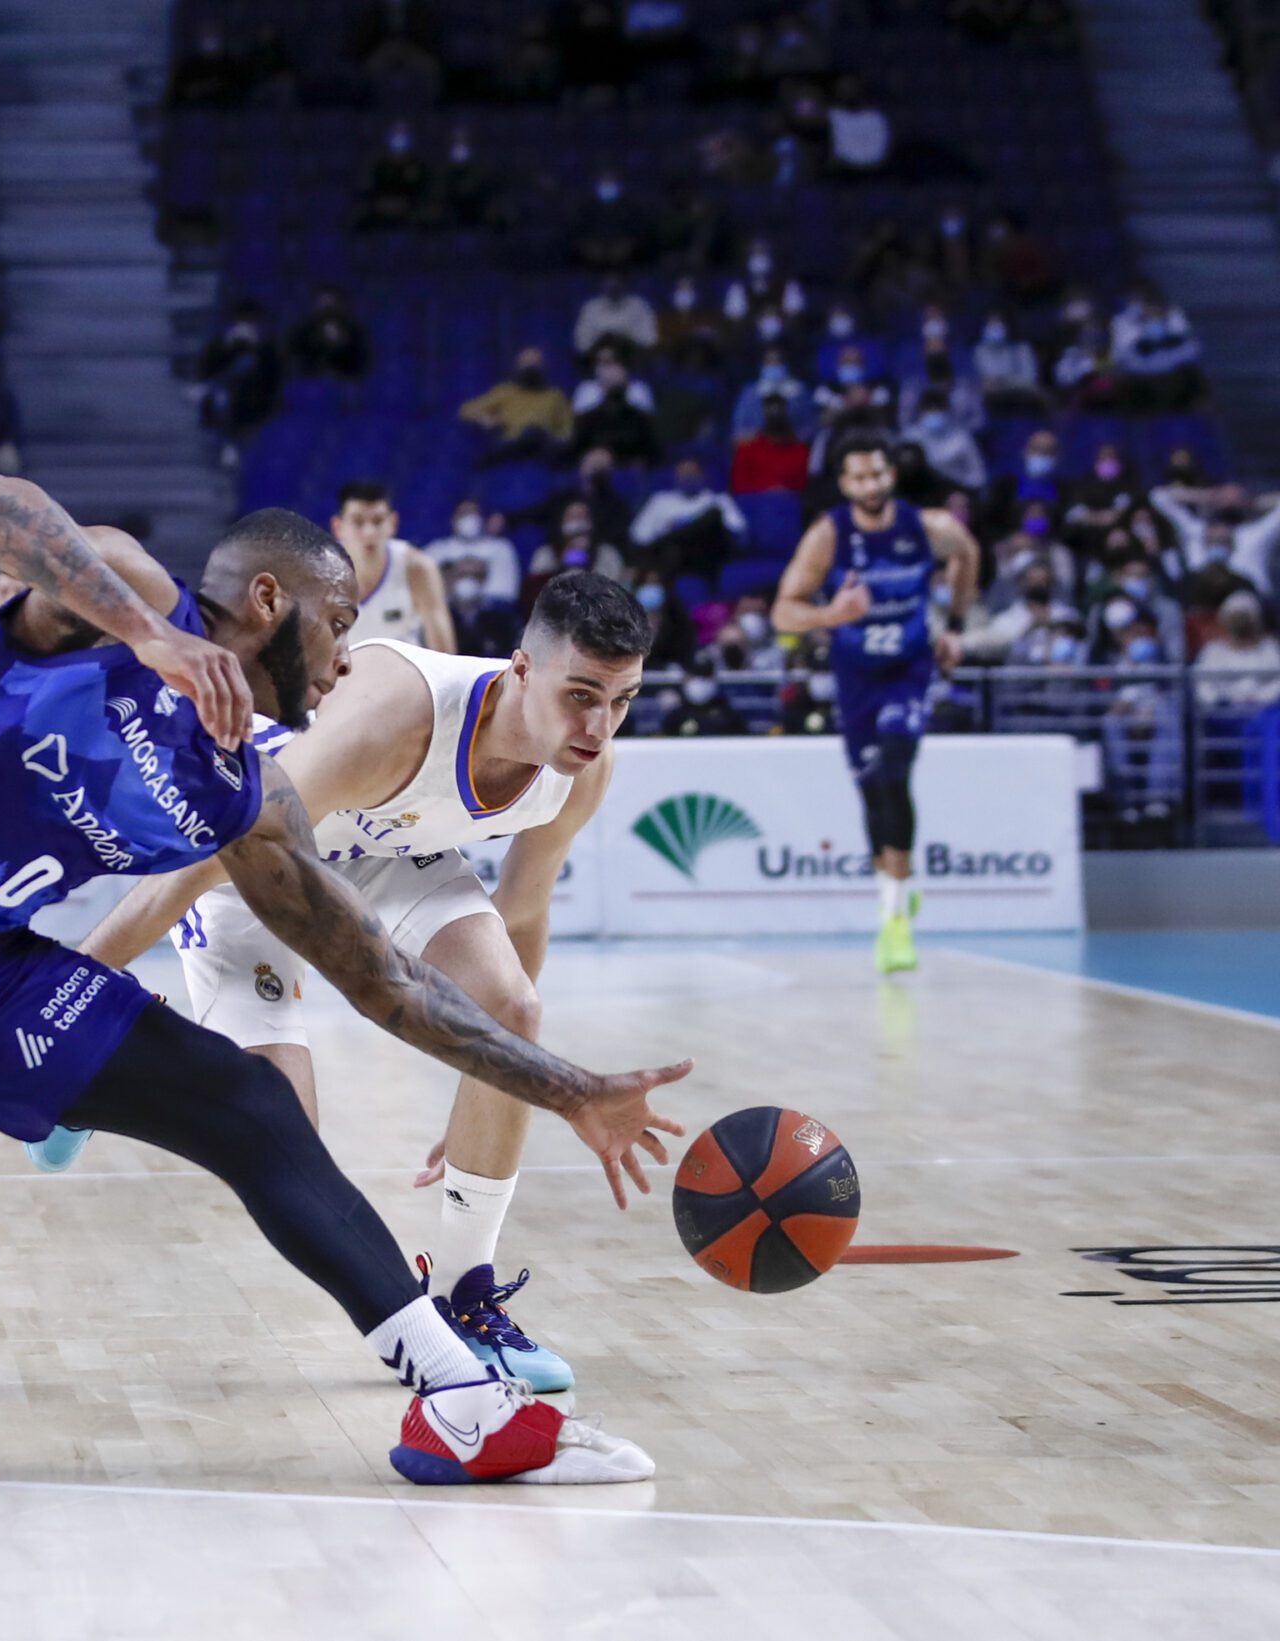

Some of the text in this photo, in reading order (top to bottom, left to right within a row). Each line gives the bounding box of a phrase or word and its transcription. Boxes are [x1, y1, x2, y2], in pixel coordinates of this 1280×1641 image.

[863, 622, 905, 656] 22
[120, 716, 215, 849] MORABANC
[757, 840, 1052, 879] Unica Banco
[39, 966, 90, 1020] andorra
[53, 974, 109, 1032] telecom
